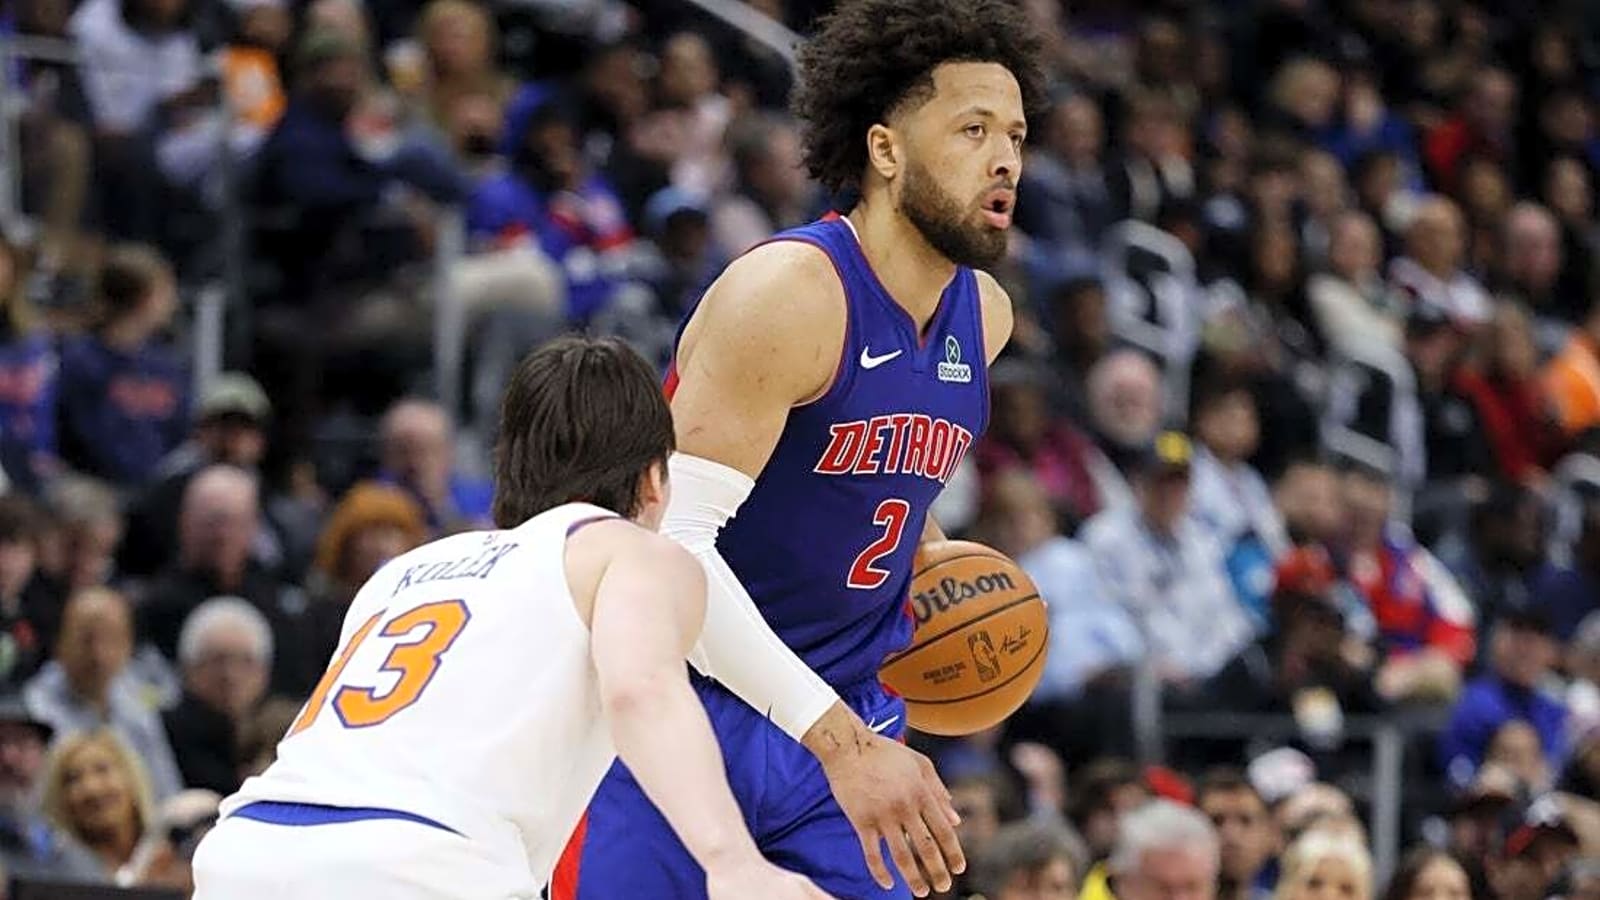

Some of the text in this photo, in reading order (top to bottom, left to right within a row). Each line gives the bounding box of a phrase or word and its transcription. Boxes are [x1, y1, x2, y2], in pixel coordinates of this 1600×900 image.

[940, 365, 970, 380] StockX
[814, 413, 973, 488] DETROIT
[391, 541, 519, 598] KOLEK
[846, 499, 910, 589] 2
[286, 598, 472, 739] 13
